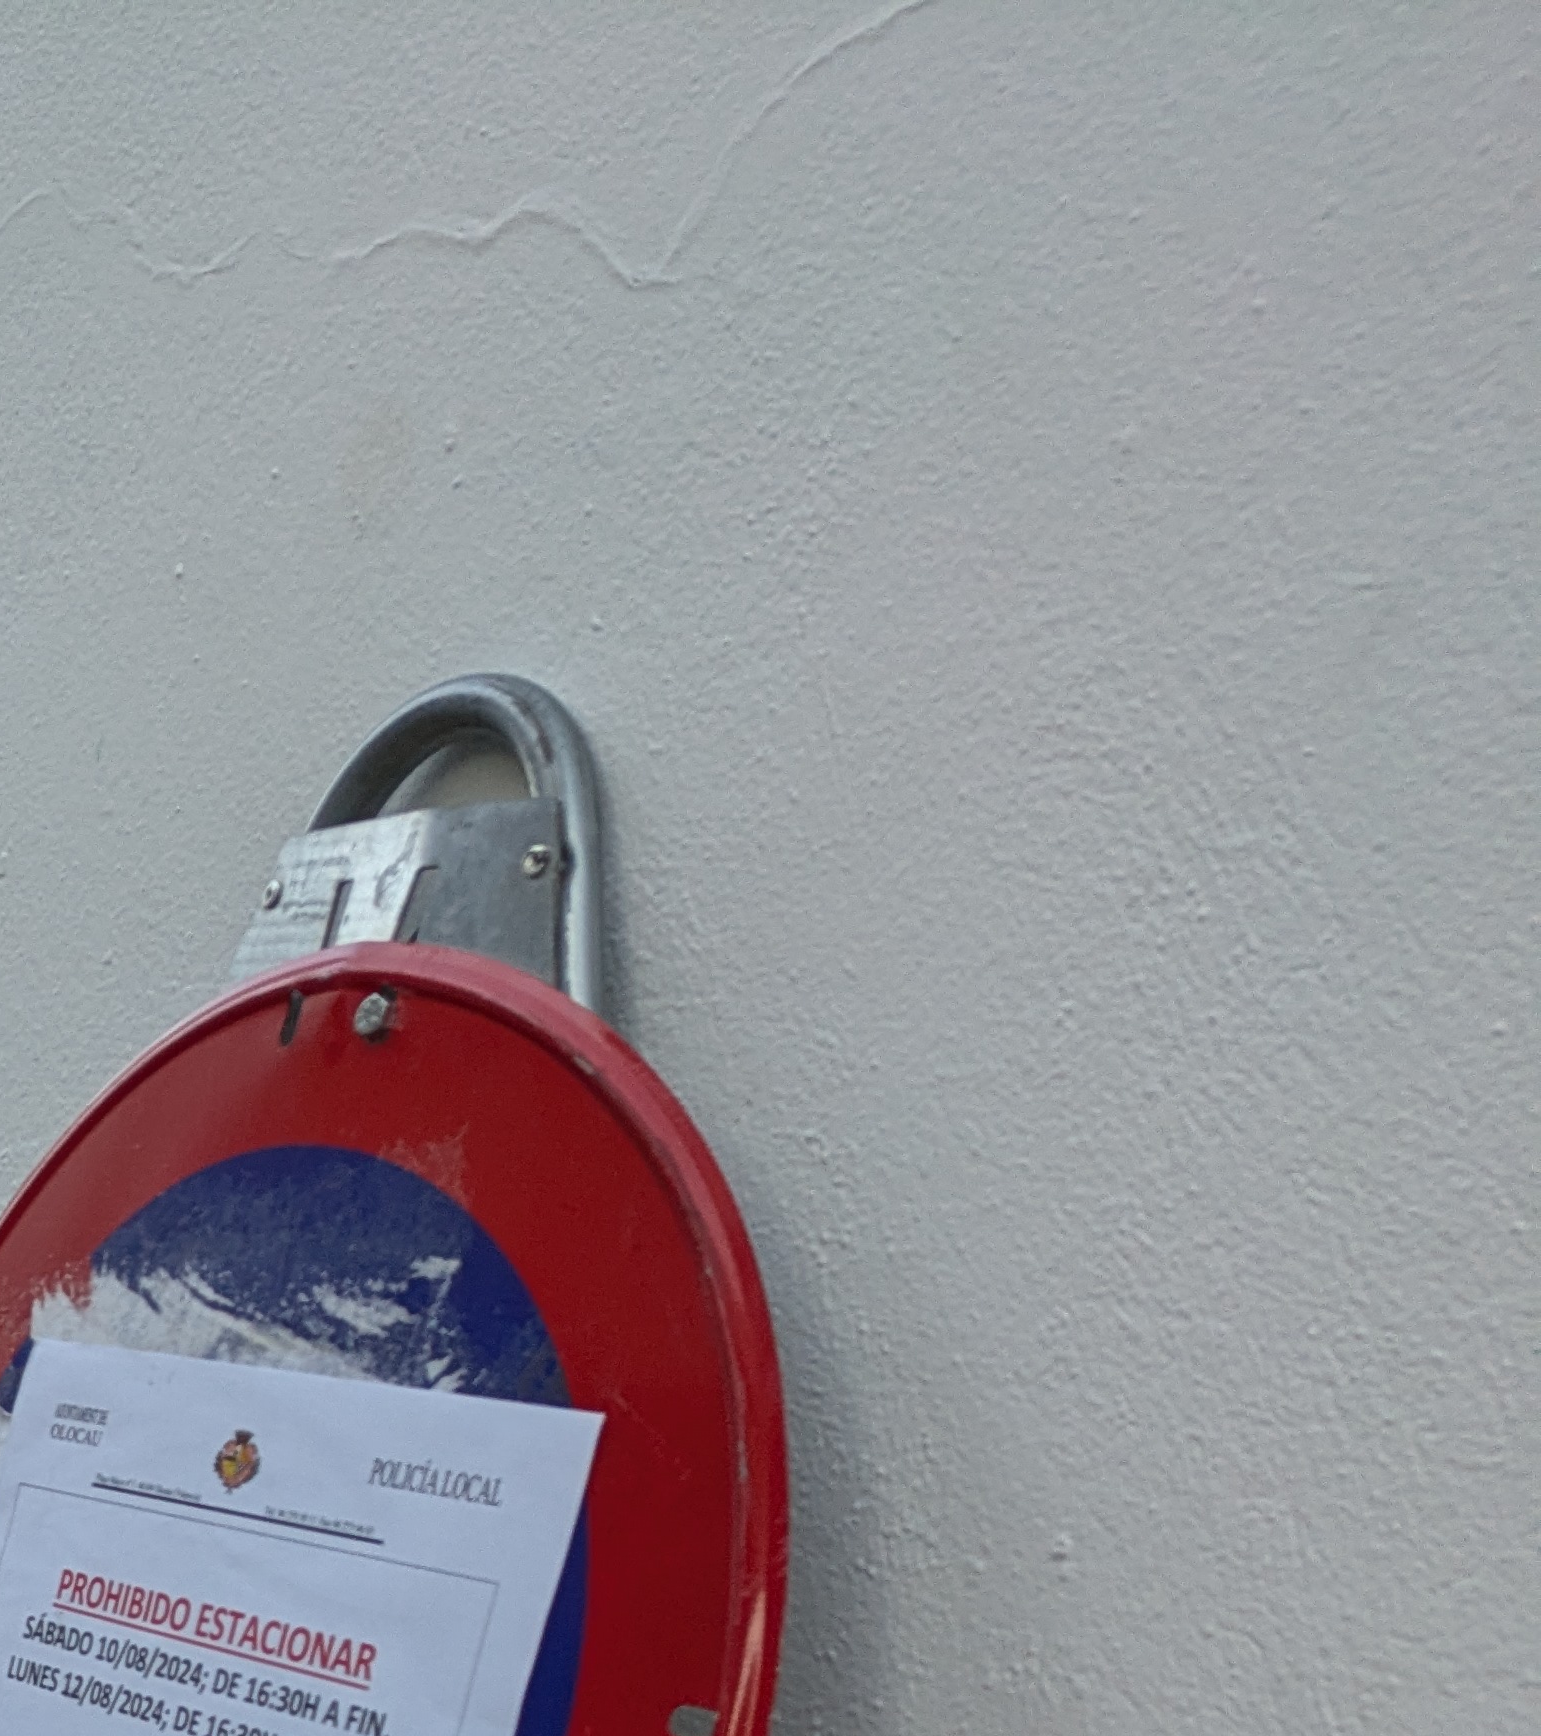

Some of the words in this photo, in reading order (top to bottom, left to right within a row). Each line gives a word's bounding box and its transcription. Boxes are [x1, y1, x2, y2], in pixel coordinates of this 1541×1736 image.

[368, 1457, 439, 1496] POLICÍA
[438, 1468, 502, 1507] LOCAL
[22, 1612, 94, 1655] SÁBADO
[95, 1636, 209, 1695] 10/08/2024;
[211, 1667, 243, 1699] DE
[243, 1677, 321, 1722] 16:30H
[321, 1699, 341, 1728] A
[55, 1568, 192, 1632] PROHIBIDO
[194, 1603, 377, 1681] ESTACIONAR
[7, 1655, 61, 1692] LUNES
[61, 1672, 170, 1731] 12/08/2024;
[173, 1705, 203, 1736] DE
